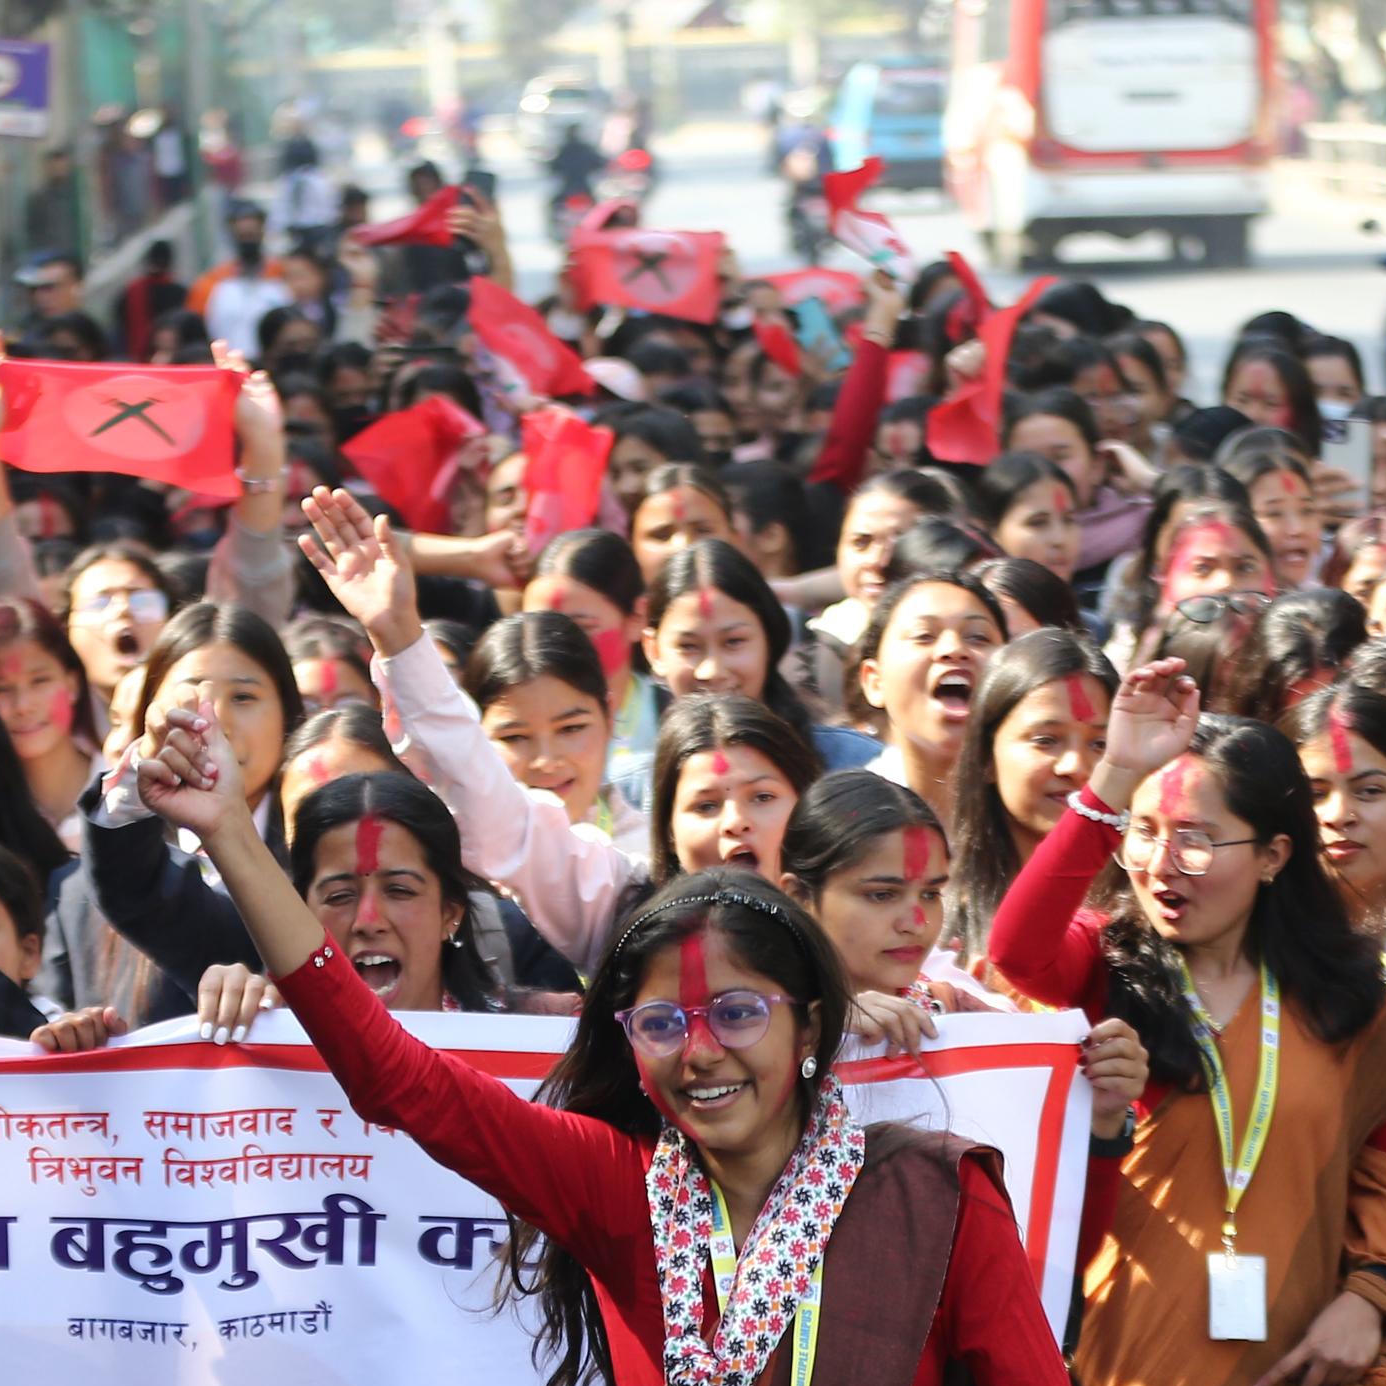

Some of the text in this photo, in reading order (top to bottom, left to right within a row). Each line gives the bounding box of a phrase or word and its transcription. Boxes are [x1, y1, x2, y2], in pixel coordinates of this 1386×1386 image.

[144, 1109, 297, 1138] समाजवाद
[317, 1110, 341, 1136] र
[28, 1145, 373, 1196] त्रिभुवन विश्वविद्यालय
[51, 1193, 387, 1295] बहुमुखी
[69, 1301, 332, 1352] बागबजार, काठमाडौं
[799, 1309, 813, 1350] CAMPUS
